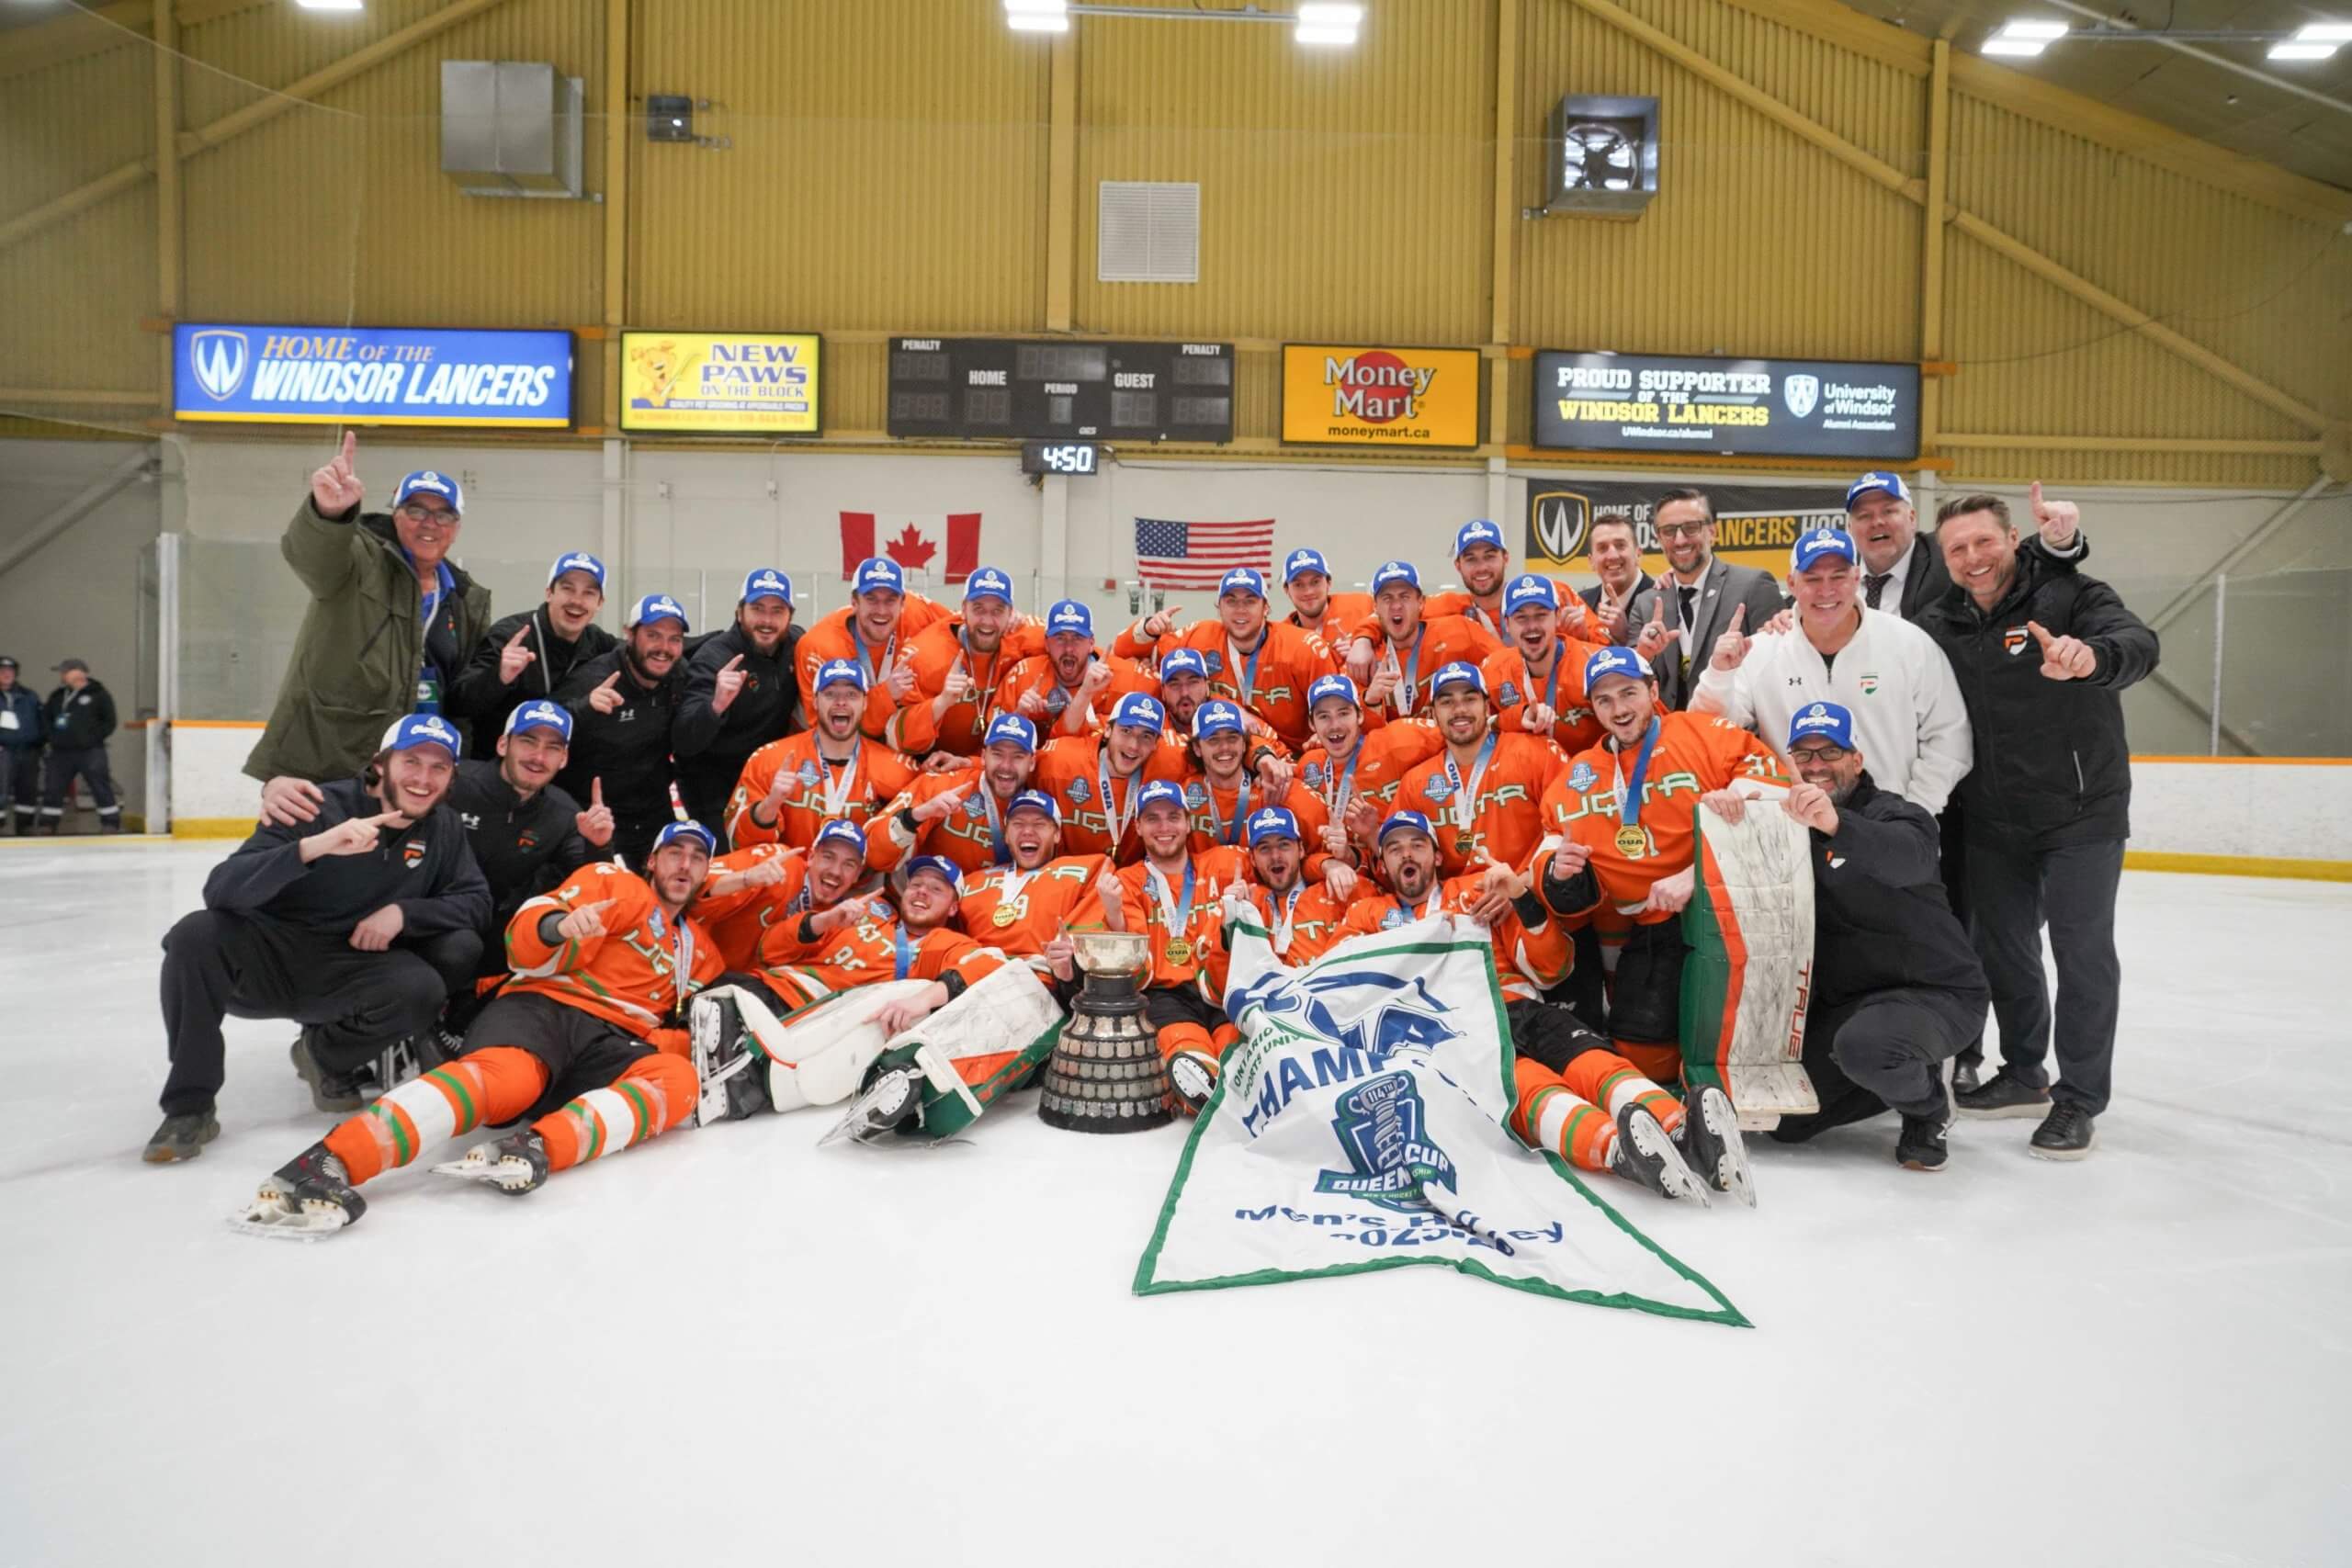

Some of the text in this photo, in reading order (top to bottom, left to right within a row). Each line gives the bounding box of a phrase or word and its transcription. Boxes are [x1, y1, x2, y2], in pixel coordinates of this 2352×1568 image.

[262, 335, 436, 363] HOME OF THE
[712, 344, 797, 363] NEW
[901, 340, 942, 351] PENALTY
[1182, 344, 1222, 355] PENALTY
[251, 359, 557, 407] WINDSOR LANCERS
[702, 365, 808, 384] PAWS
[968, 370, 1008, 386] HOME
[1114, 373, 1156, 389] GUEST
[1323, 356, 1437, 395] Money
[1557, 367, 1771, 395] PROUD SUPPORTER
[701, 384, 805, 398] ON THE BLOCK
[1044, 382, 1079, 395] PERIOD
[1637, 391, 1690, 405] OF THE
[1824, 383, 1897, 404] University
[1332, 389, 1419, 419] Mart
[1558, 400, 1770, 427] WINDSOR LANCERS
[1835, 399, 1896, 415] Windsor
[1328, 425, 1430, 439] moneymart.ca
[1043, 446, 1092, 472] 4:50
[1634, 503, 1653, 522] OF
[1711, 516, 1796, 547] ANCERS
[1234, 1026, 1273, 1088] ONTARIO
[1243, 1053, 1262, 1100] SPORTS
[1367, 1081, 1395, 1102] 114TH
[1235, 1204, 1386, 1227] Men's
